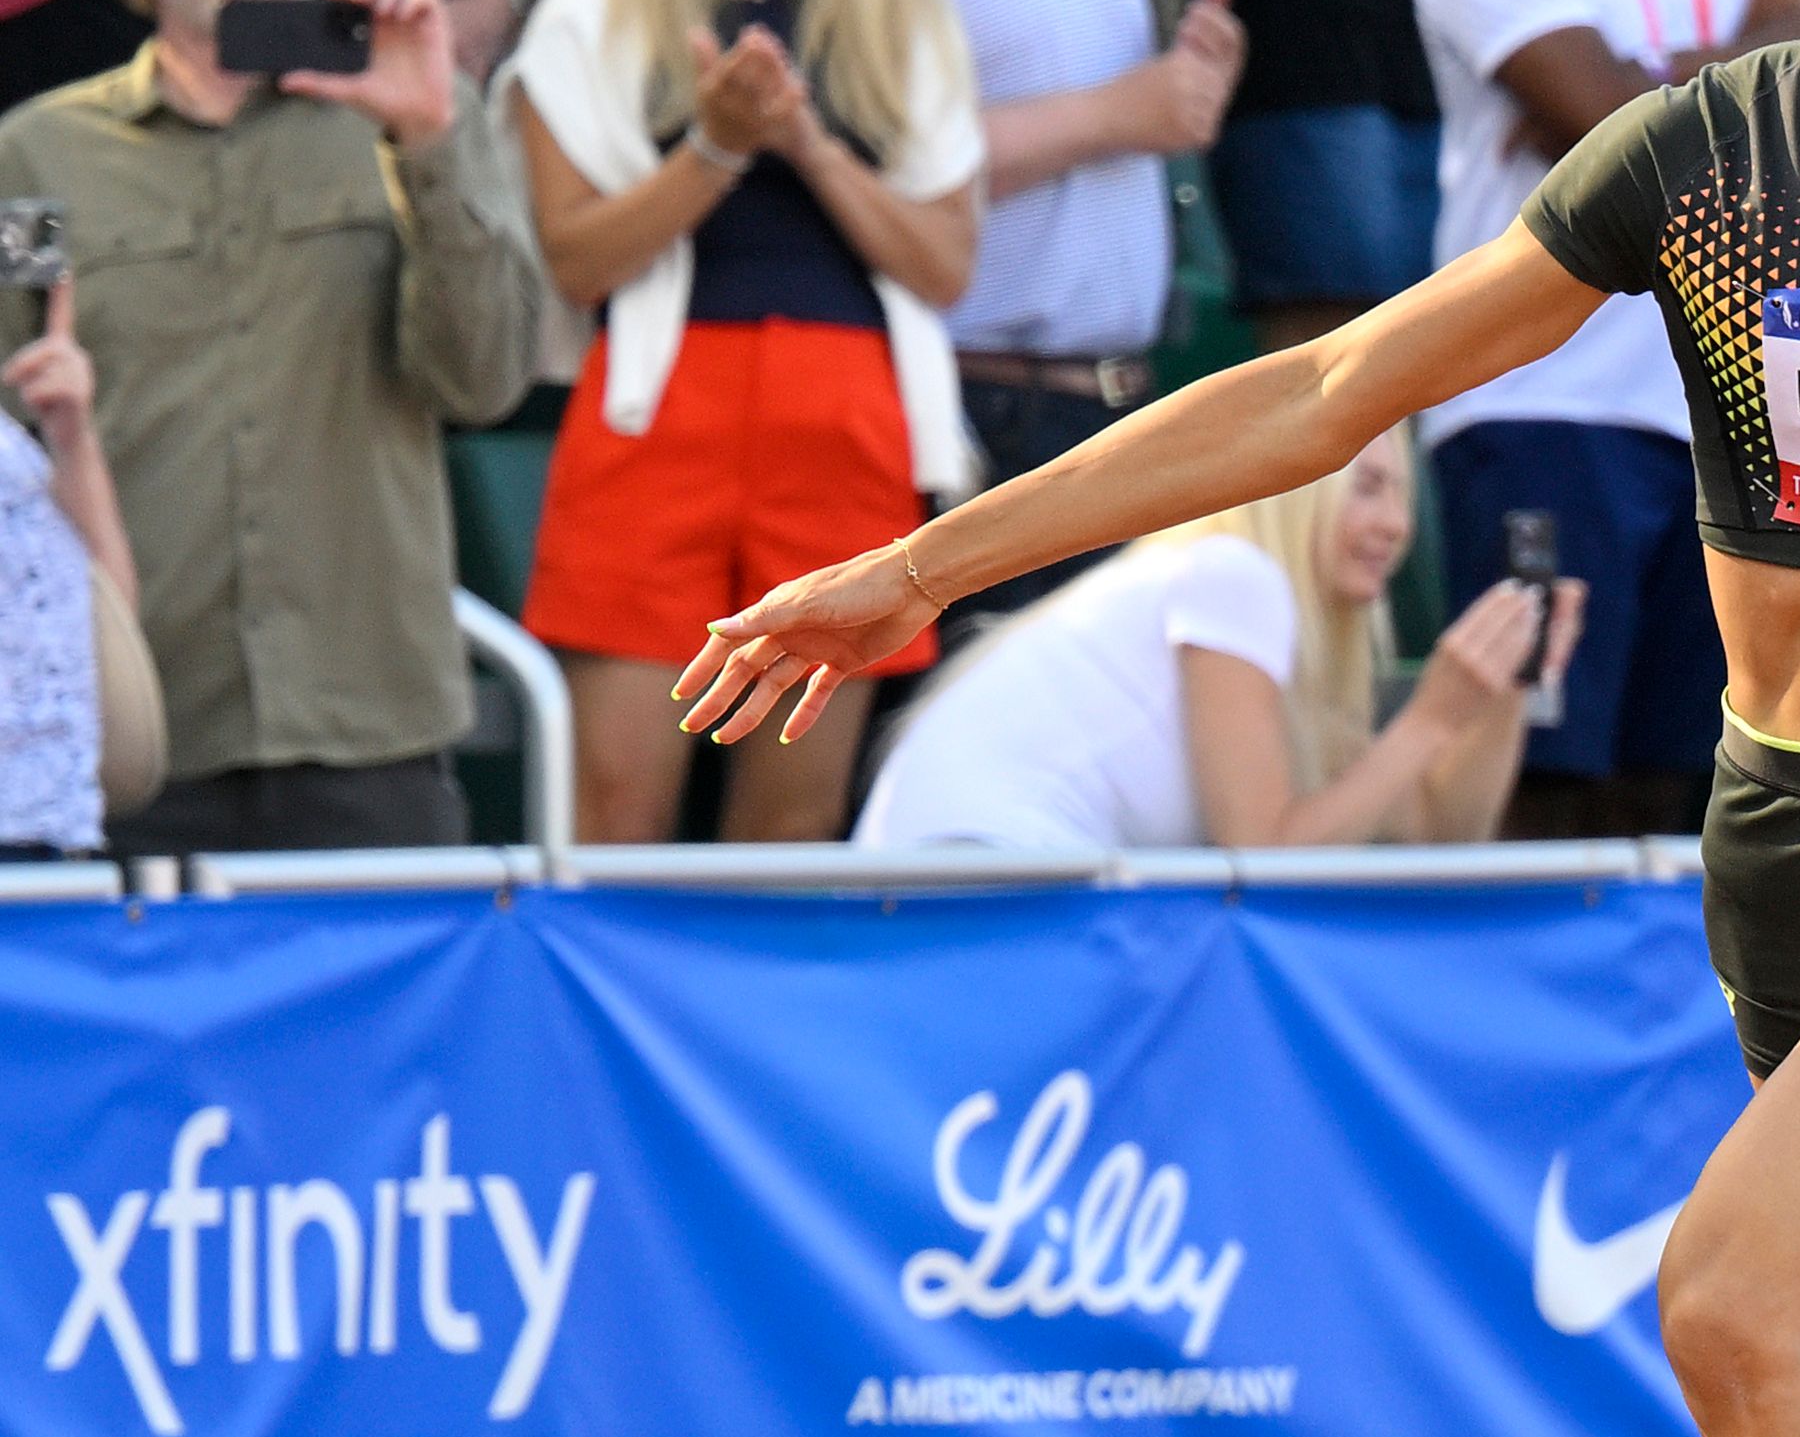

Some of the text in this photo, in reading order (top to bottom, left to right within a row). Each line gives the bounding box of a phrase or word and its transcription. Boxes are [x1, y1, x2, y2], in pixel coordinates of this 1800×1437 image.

[902, 1068, 1246, 1360] Lilly
[846, 1366, 1299, 1426] A MEDICINE COMPANY
